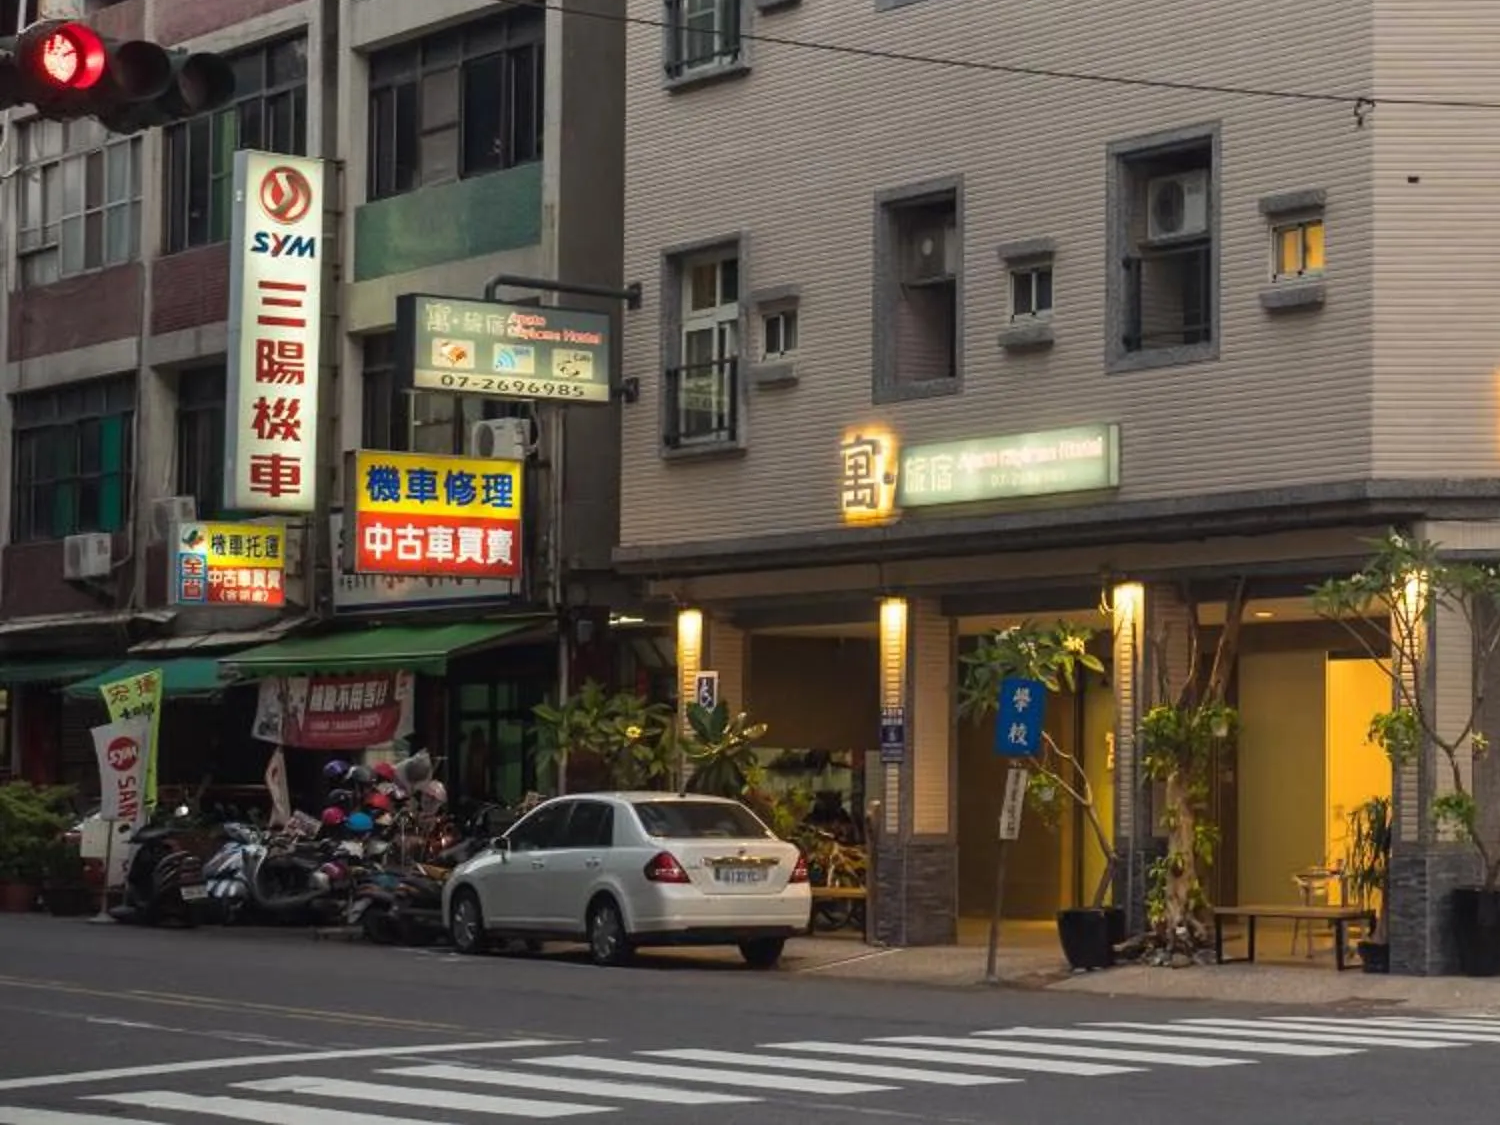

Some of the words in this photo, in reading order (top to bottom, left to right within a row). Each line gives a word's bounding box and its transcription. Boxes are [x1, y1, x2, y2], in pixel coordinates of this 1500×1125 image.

[250, 230, 316, 259] SYM
[249, 279, 307, 499] 三陽機車
[441, 374, 585, 398] 07-2696985
[365, 463, 514, 509] 機車修理
[364, 523, 514, 566] 中古車買賣
[207, 567, 281, 590] 中古車買賣
[1007, 687, 1031, 747] 學校
